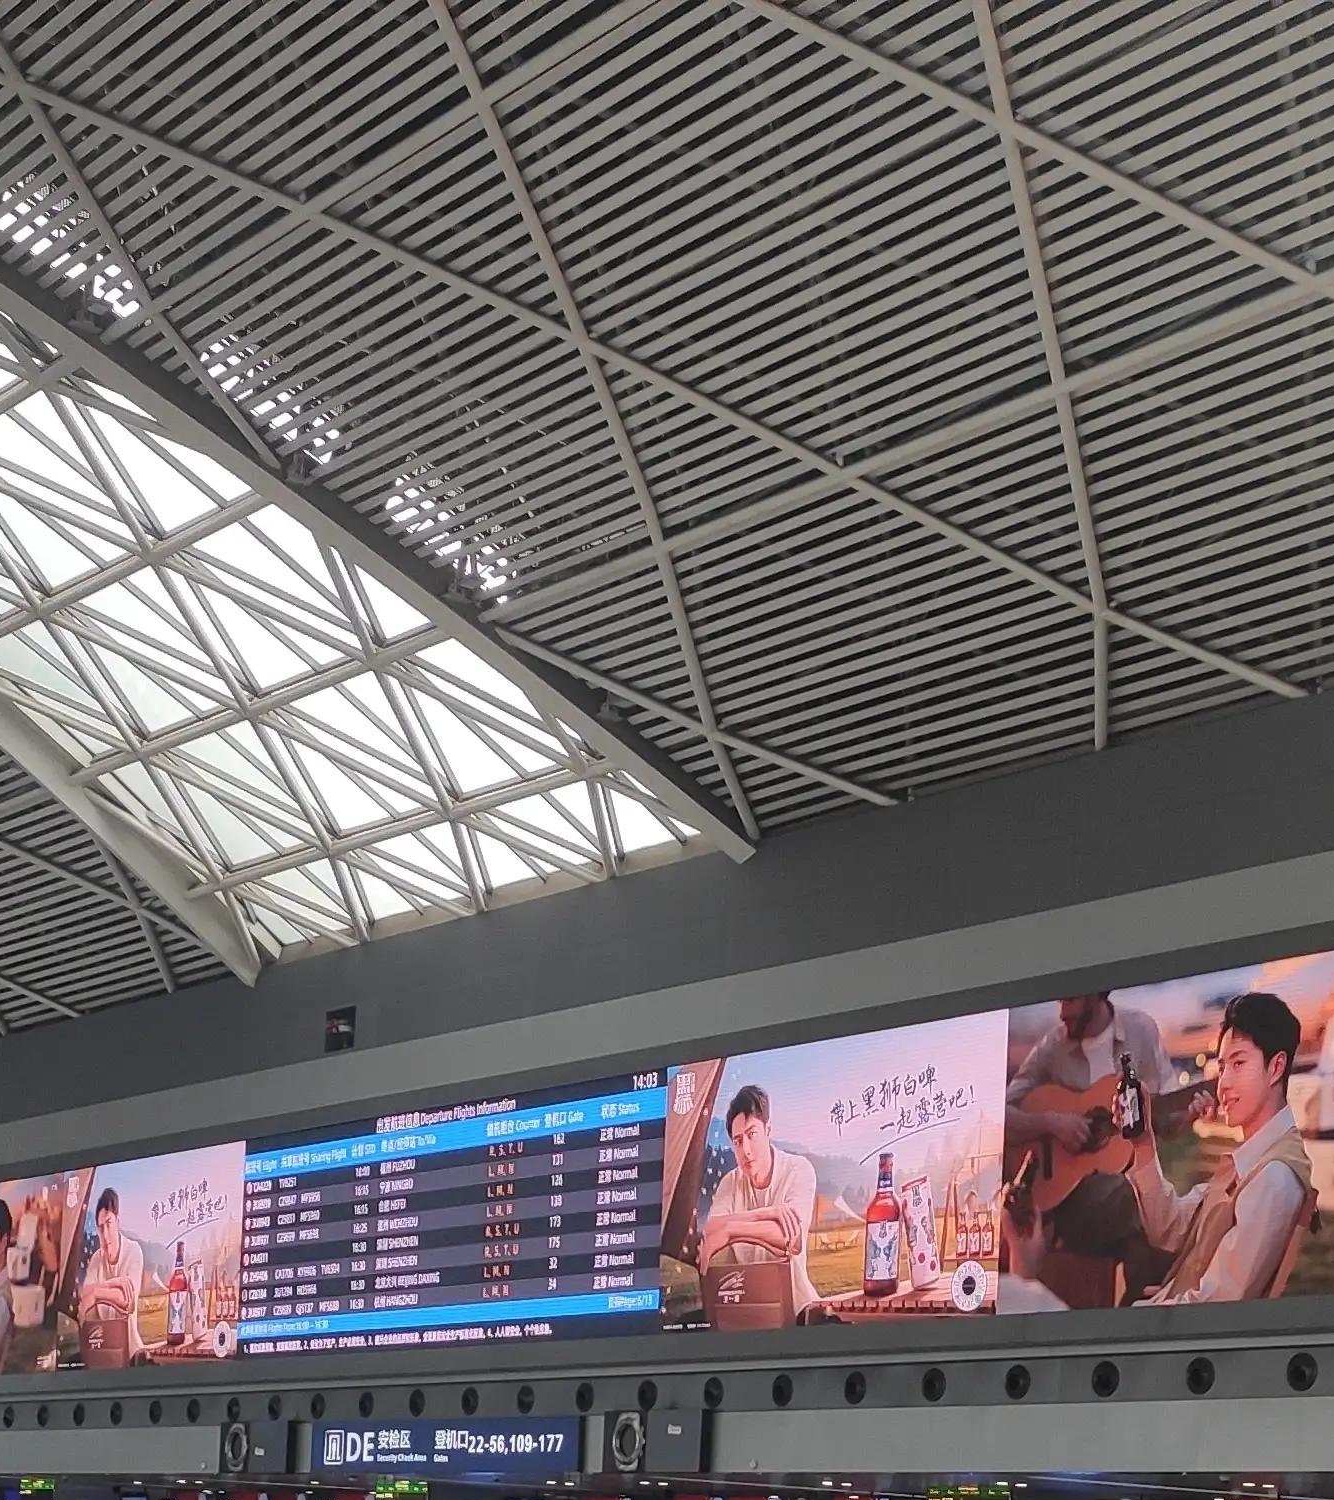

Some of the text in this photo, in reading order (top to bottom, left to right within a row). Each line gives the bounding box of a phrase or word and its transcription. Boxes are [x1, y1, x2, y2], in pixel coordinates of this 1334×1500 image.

[632, 1072, 658, 1090] 14:03
[420, 1107, 453, 1127] Departure
[453, 1102, 475, 1121] Flights
[476, 1098, 516, 1116] Information
[615, 1123, 640, 1139] Normal
[614, 1144, 639, 1160] Normal
[613, 1166, 638, 1181] Normal
[611, 1187, 637, 1203] Normal
[388, 1235, 419, 1249] SHENZHEN
[610, 1209, 637, 1224] Normal
[388, 1255, 418, 1268] SHENZHEN
[609, 1230, 636, 1245] Normal
[418, 1271, 440, 1284] DAXING
[609, 1252, 635, 1266] Normal
[386, 1293, 418, 1307] HANGZHOU
[607, 1272, 634, 1288] Normal
[346, 1432, 375, 1462] DE
[378, 1429, 564, 1455] 安检区 登机口 22-56,109-177
